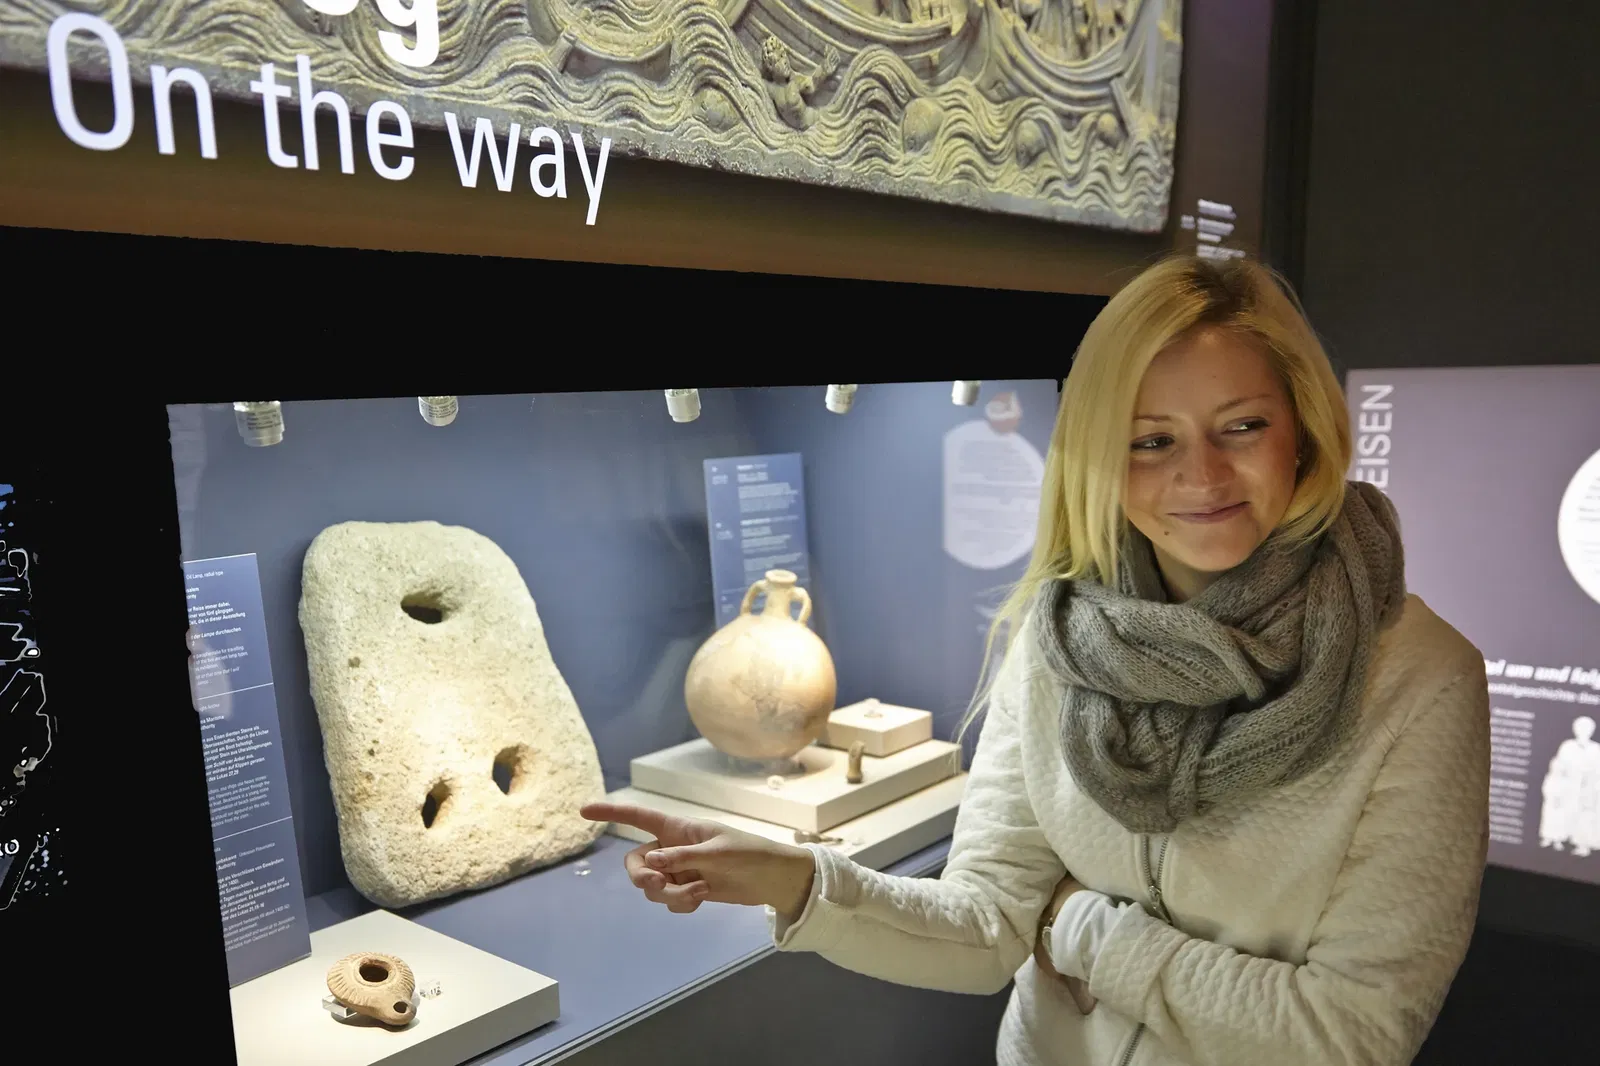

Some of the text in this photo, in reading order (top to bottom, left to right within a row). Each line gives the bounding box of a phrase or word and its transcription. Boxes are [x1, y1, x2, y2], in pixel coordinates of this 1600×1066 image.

[47, 12, 218, 160] On
[250, 55, 415, 181] the
[444, 110, 611, 225] way
[1356, 384, 1394, 493] EISEN
